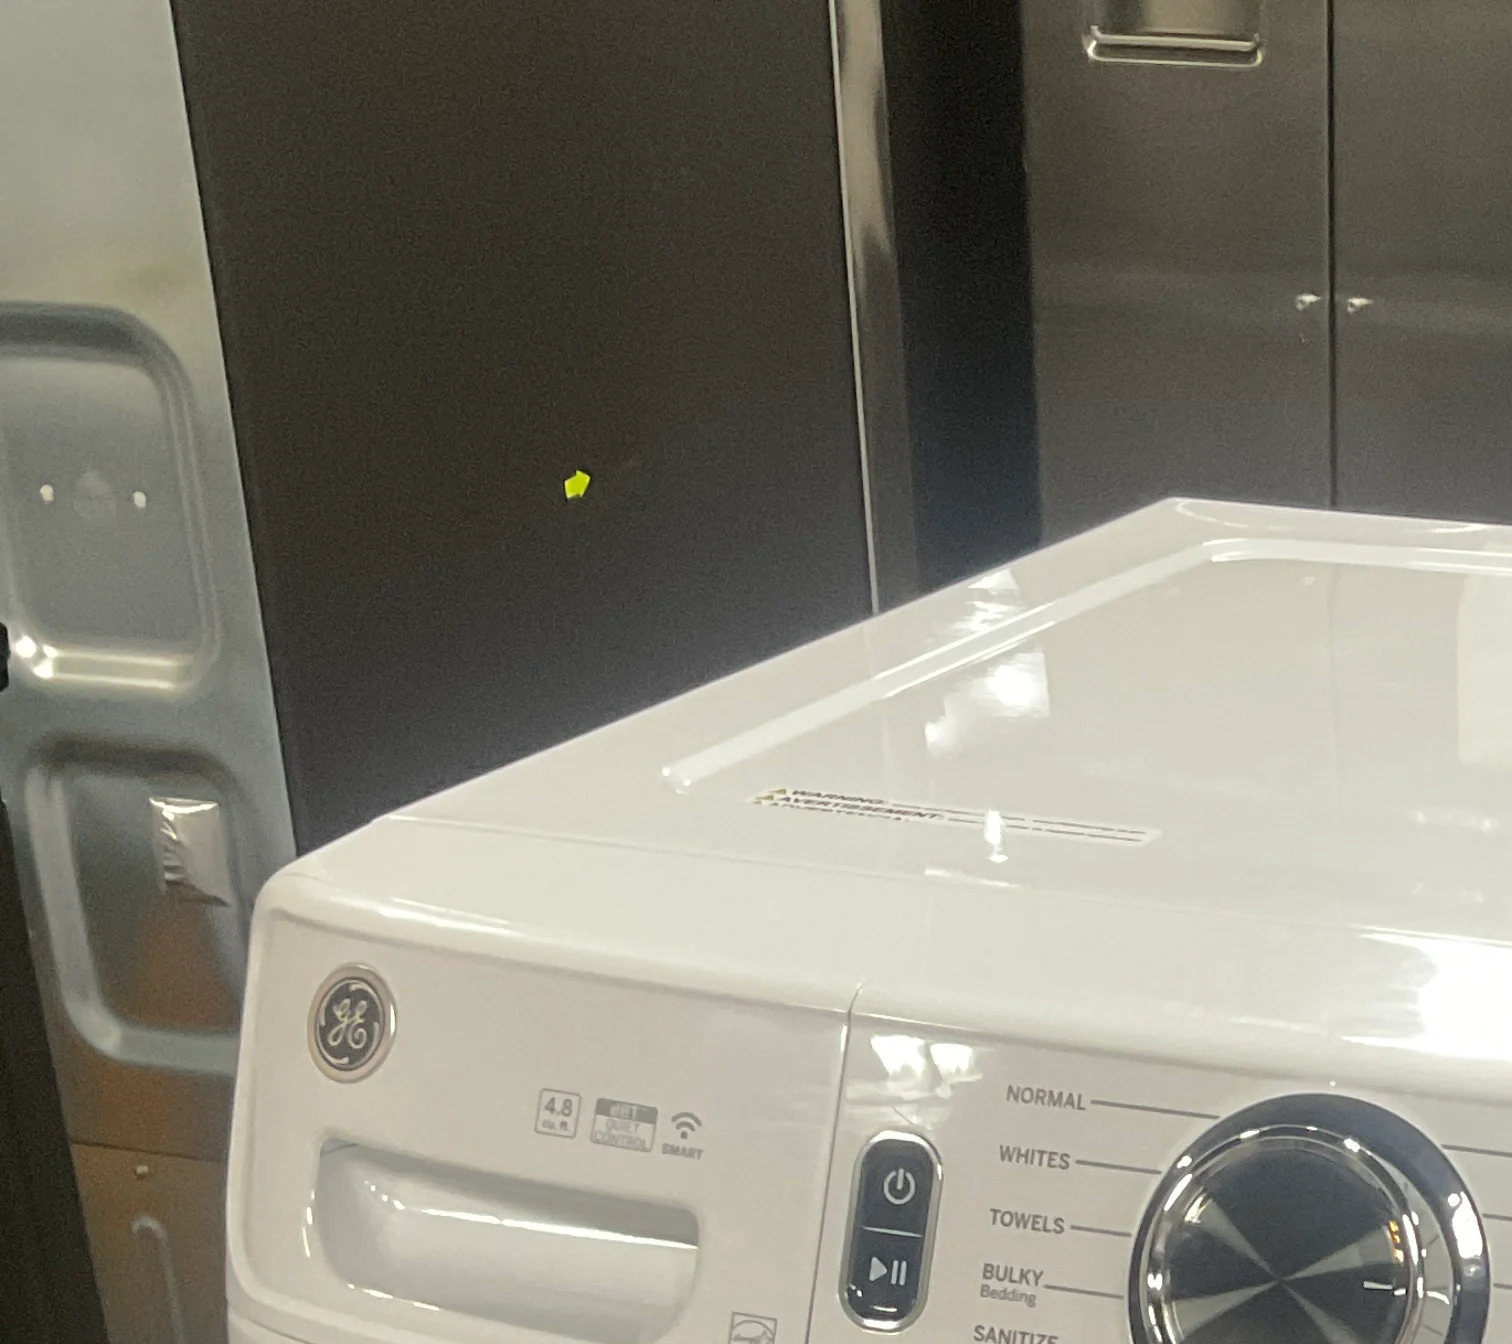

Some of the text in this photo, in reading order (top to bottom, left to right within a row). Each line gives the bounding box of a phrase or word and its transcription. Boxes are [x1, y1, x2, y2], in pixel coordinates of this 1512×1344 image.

[544, 1096, 574, 1118] 4.8
[1006, 1084, 1087, 1111] NORMAL
[604, 1118, 641, 1133] QUIET
[594, 1130, 648, 1151] CONTROL
[661, 1143, 704, 1161] SMART
[999, 1144, 1071, 1170] WHITES
[989, 1207, 1065, 1235] TOWELS
[981, 1262, 1044, 1288] BULKY
[979, 1284, 1037, 1309] Bedding
